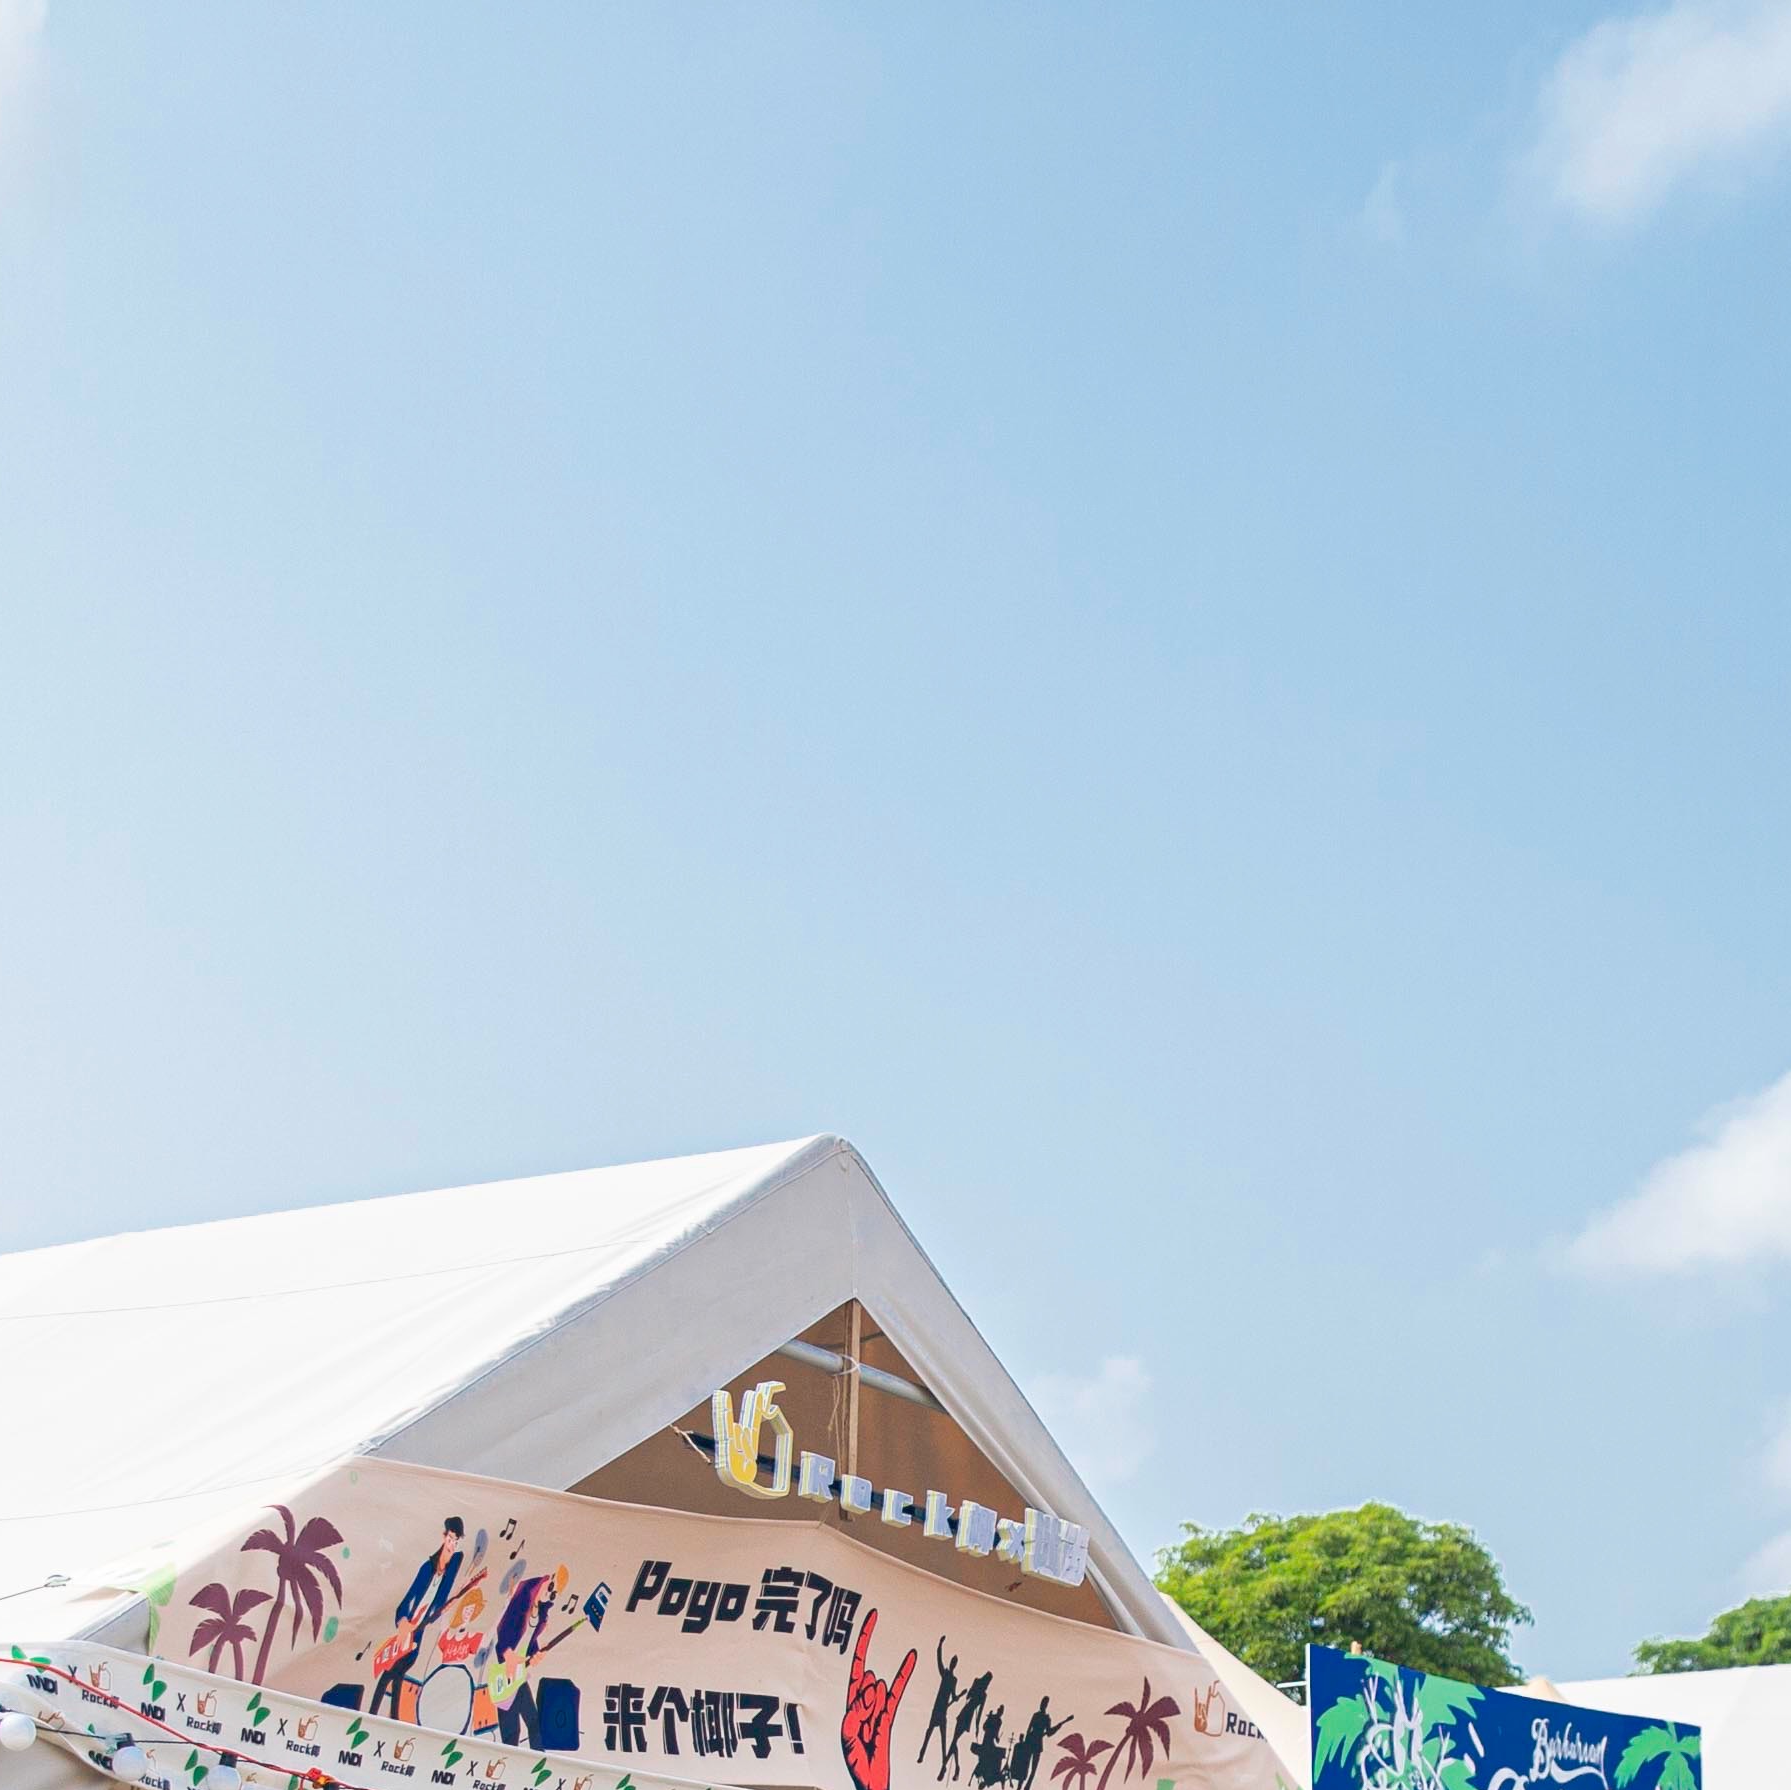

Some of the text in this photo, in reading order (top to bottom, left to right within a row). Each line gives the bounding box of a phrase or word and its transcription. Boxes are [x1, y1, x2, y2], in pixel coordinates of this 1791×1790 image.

[625, 1560, 862, 1655] Pogo 完了吗
[604, 1682, 805, 1760] 来个椰子!
